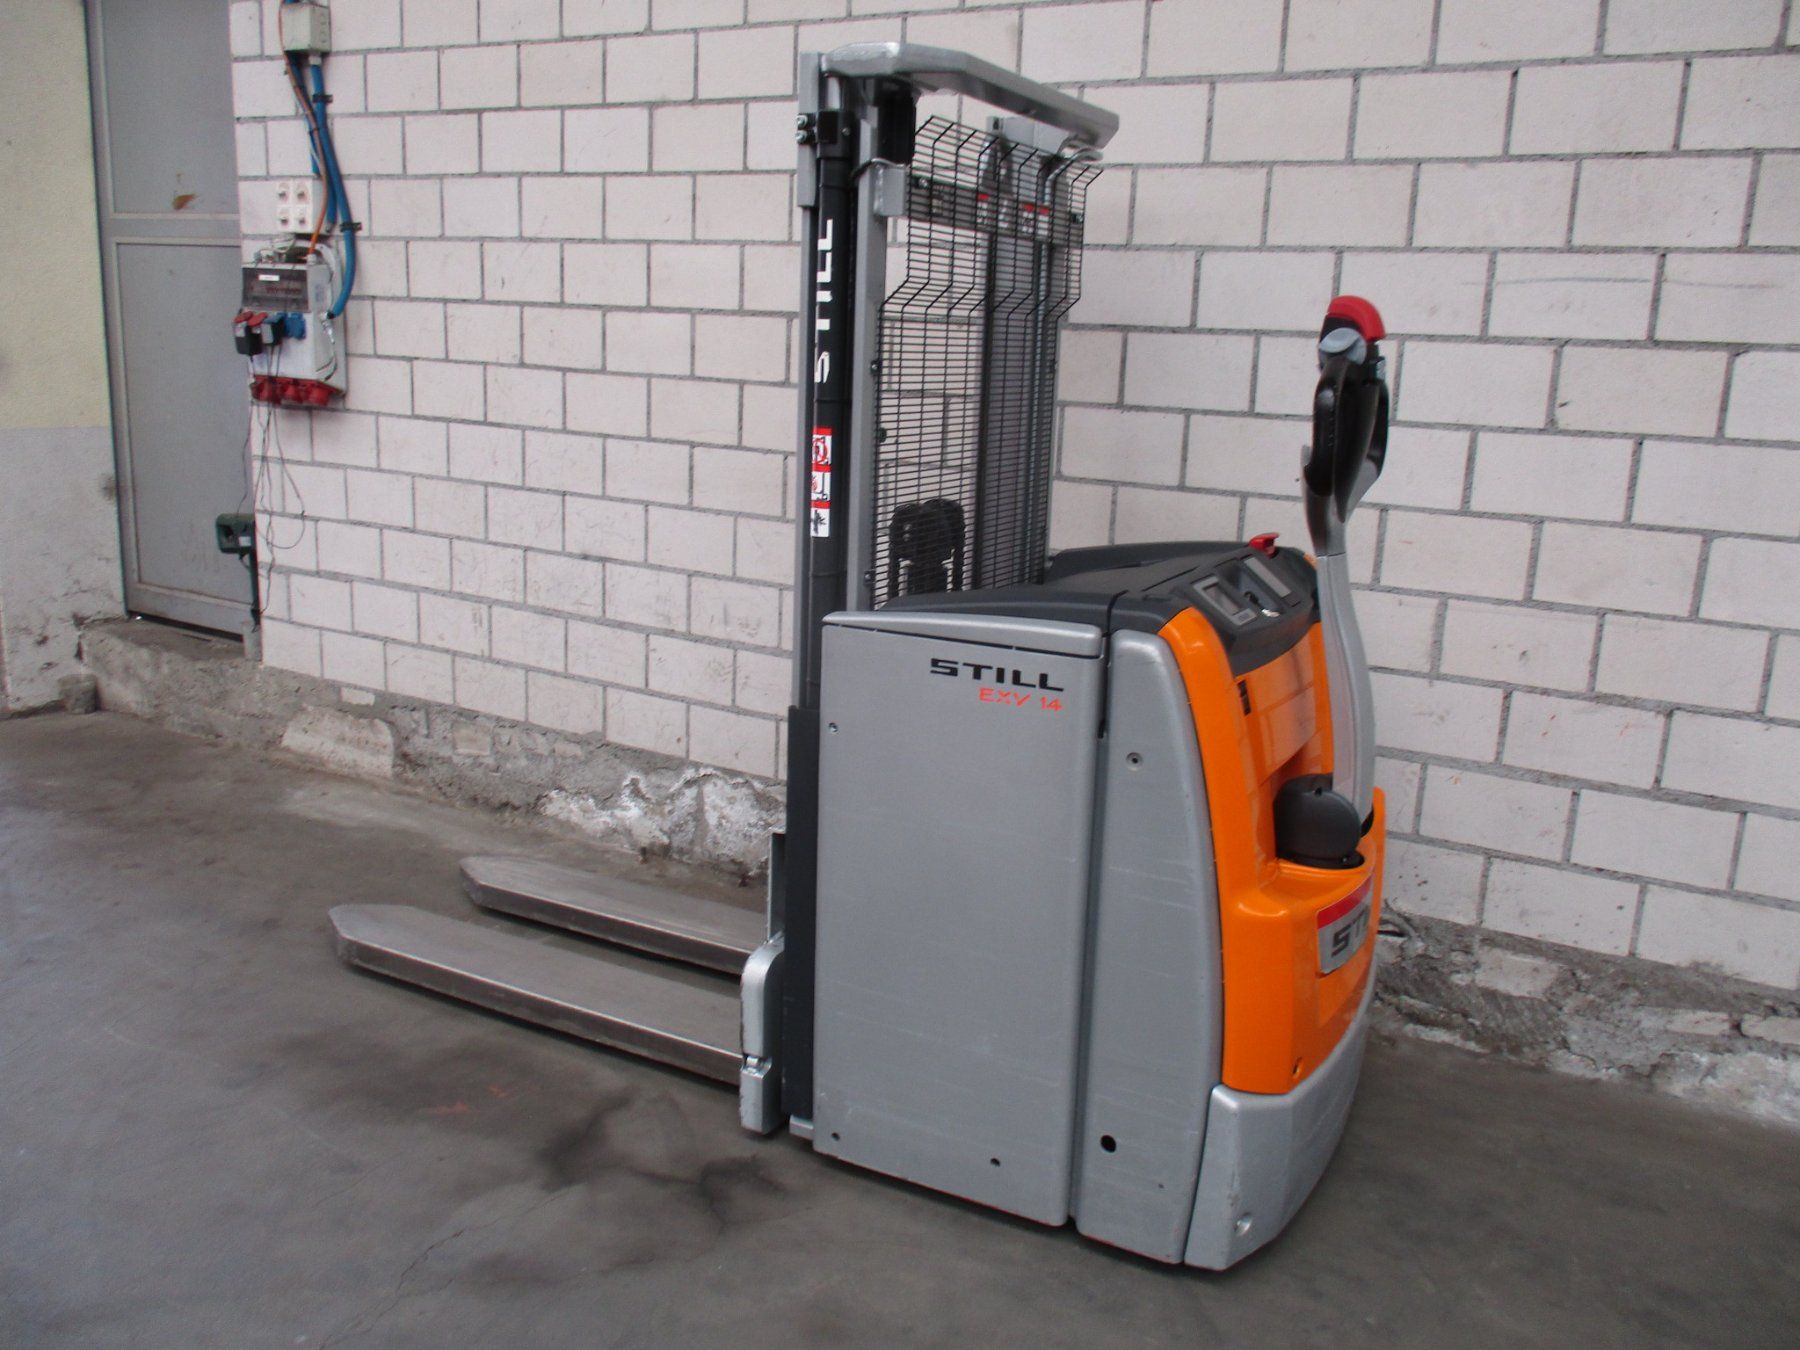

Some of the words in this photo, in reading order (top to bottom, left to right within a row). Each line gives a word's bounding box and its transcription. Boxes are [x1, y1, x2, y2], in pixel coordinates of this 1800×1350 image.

[814, 219, 833, 383] STILL
[930, 658, 1064, 692] STILL
[979, 687, 1031, 707] EXV
[1040, 696, 1063, 712] 14
[1331, 904, 1370, 958] STI
